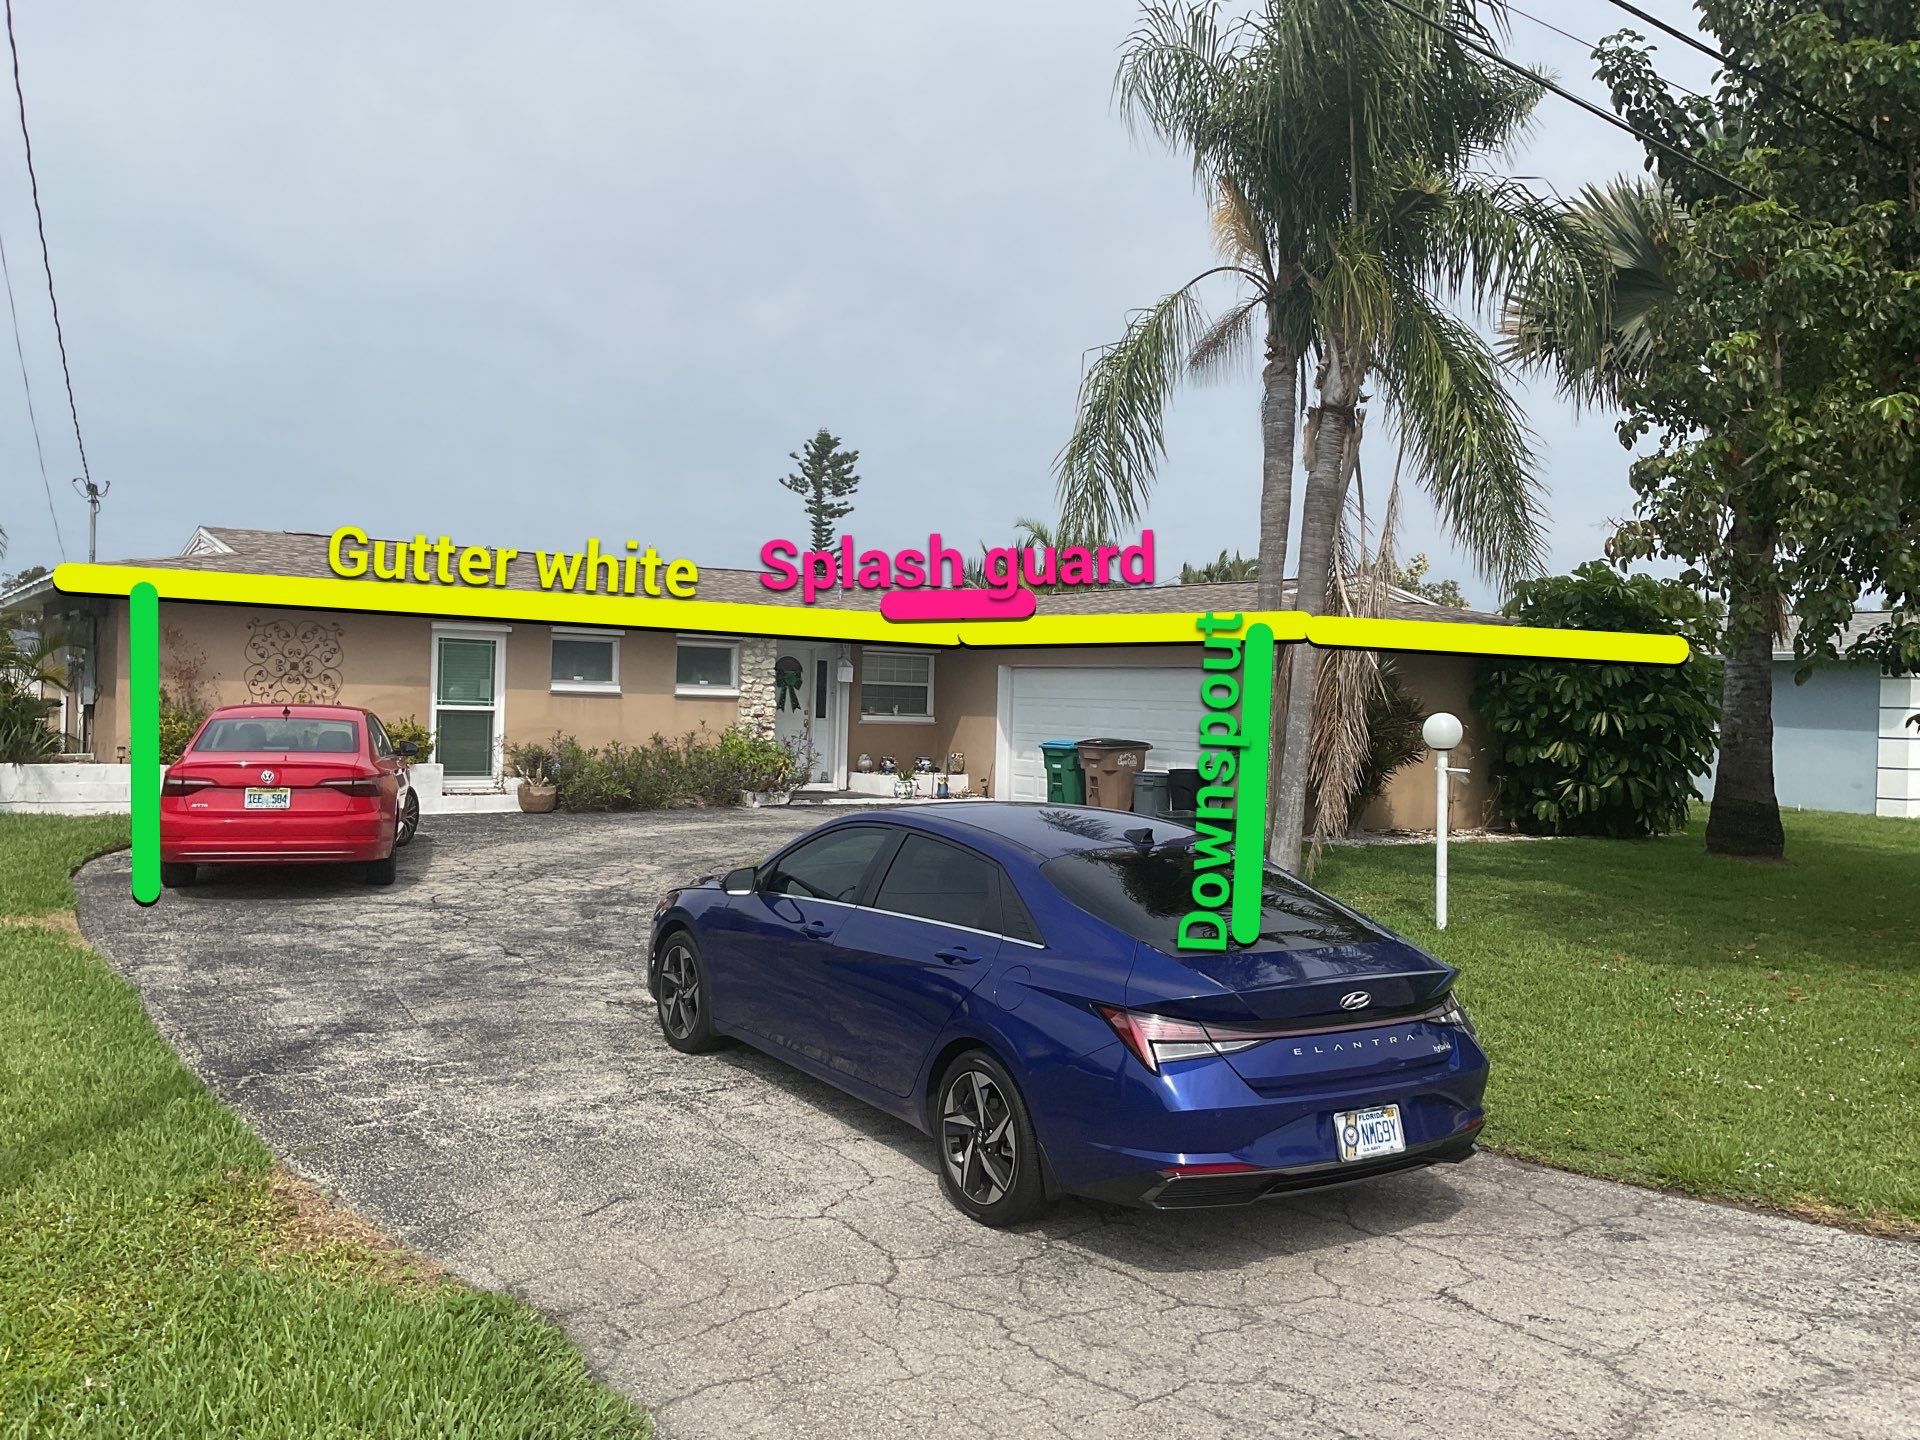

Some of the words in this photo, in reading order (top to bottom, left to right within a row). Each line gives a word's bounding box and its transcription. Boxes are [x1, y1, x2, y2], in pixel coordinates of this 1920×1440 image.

[1293, 1034, 1415, 1056] ELANTRA
[1358, 1111, 1385, 1122] FLORIDA
[1361, 1119, 1397, 1146] NMG9Y
